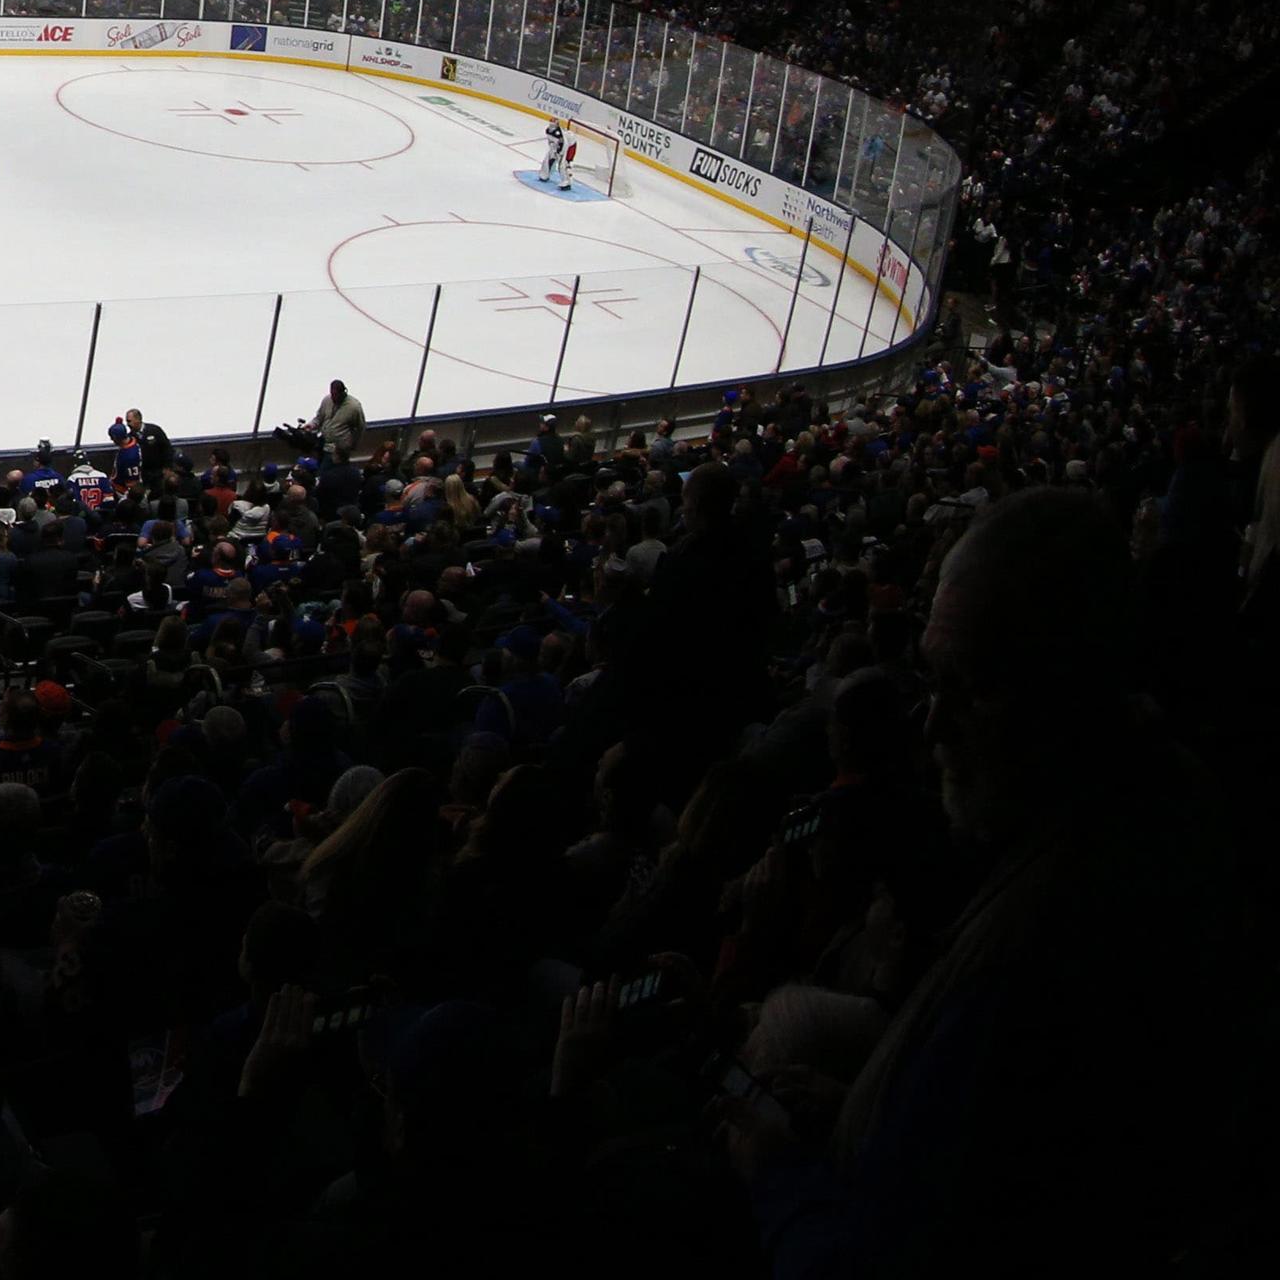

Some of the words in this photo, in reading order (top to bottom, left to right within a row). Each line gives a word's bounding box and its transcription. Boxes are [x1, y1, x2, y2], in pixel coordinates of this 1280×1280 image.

[37, 24, 75, 42] ACE
[107, 24, 133, 48] Stoli
[177, 24, 203, 48] Stoli
[273, 35, 334, 52] nationalgrid
[528, 79, 584, 114] Paramount
[618, 115, 672, 150] NATURE'S
[693, 151, 720, 180] FUN
[719, 164, 762, 198] SOCKS
